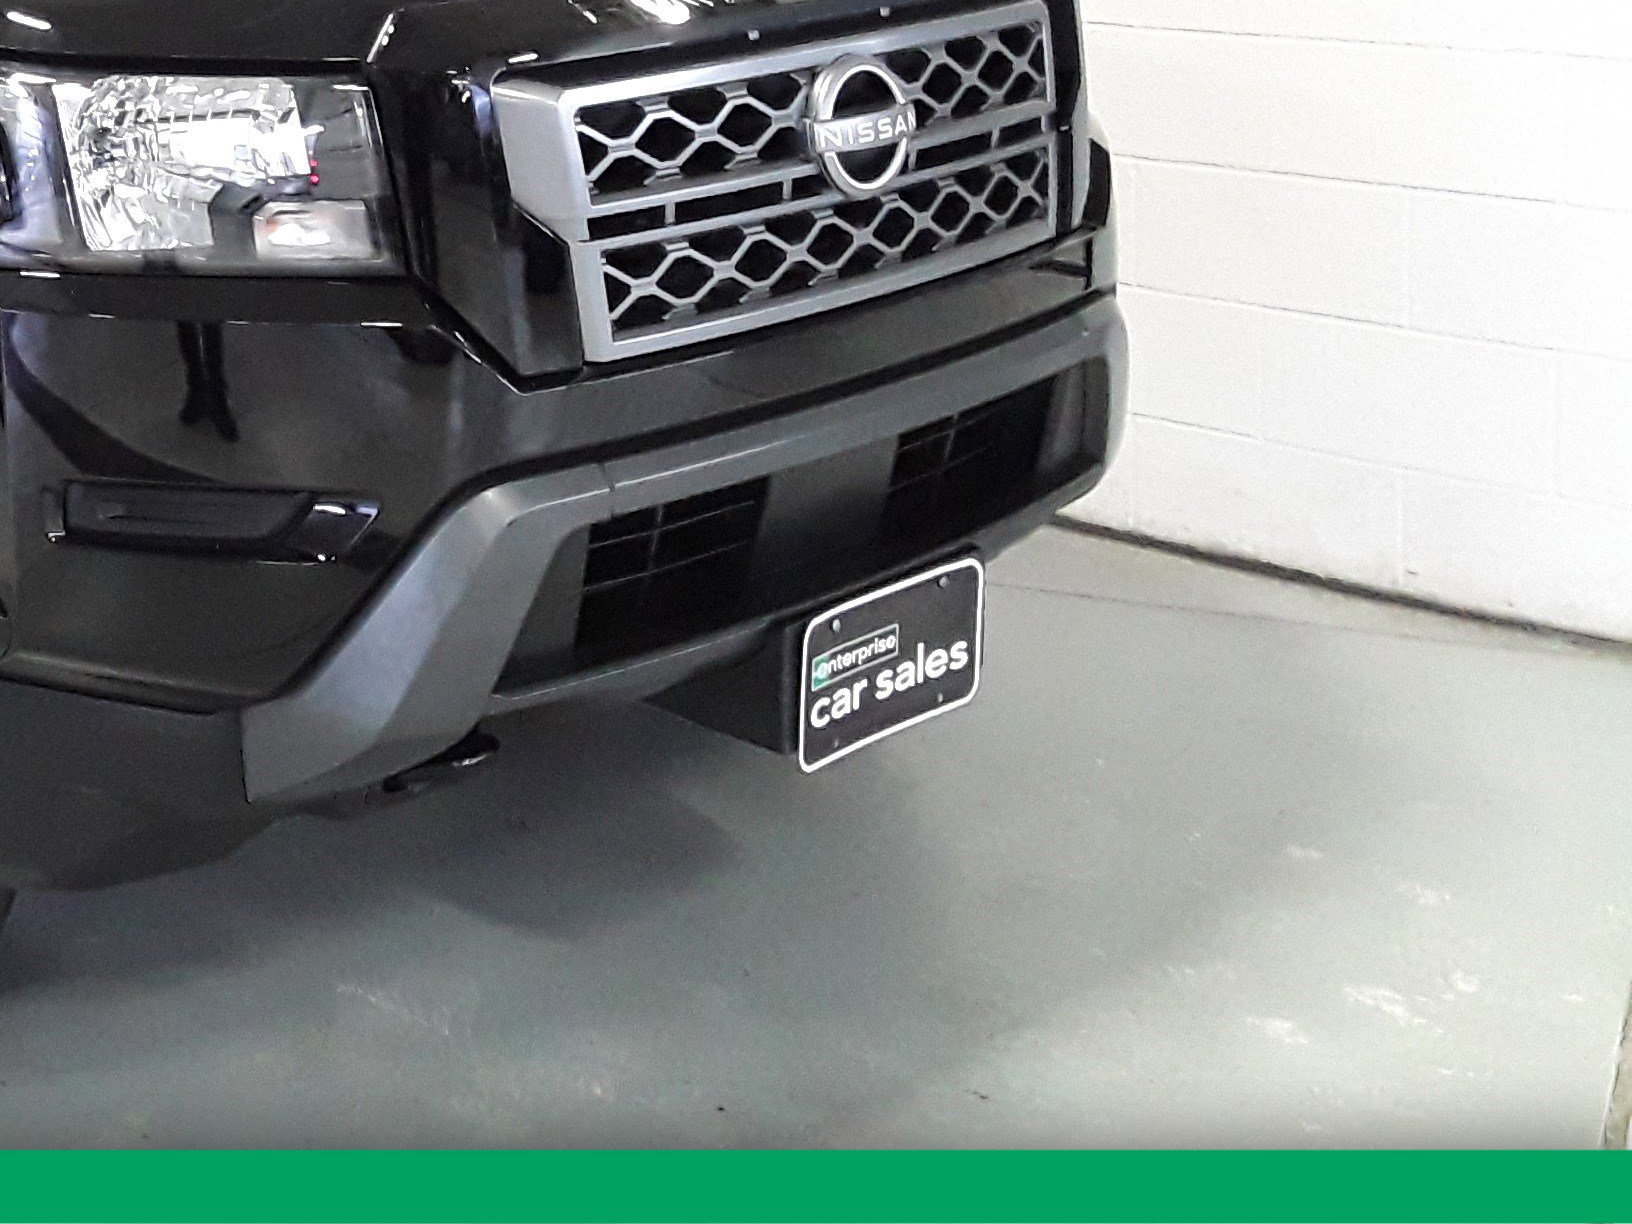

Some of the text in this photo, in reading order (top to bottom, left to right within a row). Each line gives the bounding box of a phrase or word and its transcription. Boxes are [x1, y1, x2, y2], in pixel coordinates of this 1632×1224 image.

[814, 111, 917, 148] NISSAN
[818, 633, 896, 680] enterprise
[810, 640, 968, 728] car sales
